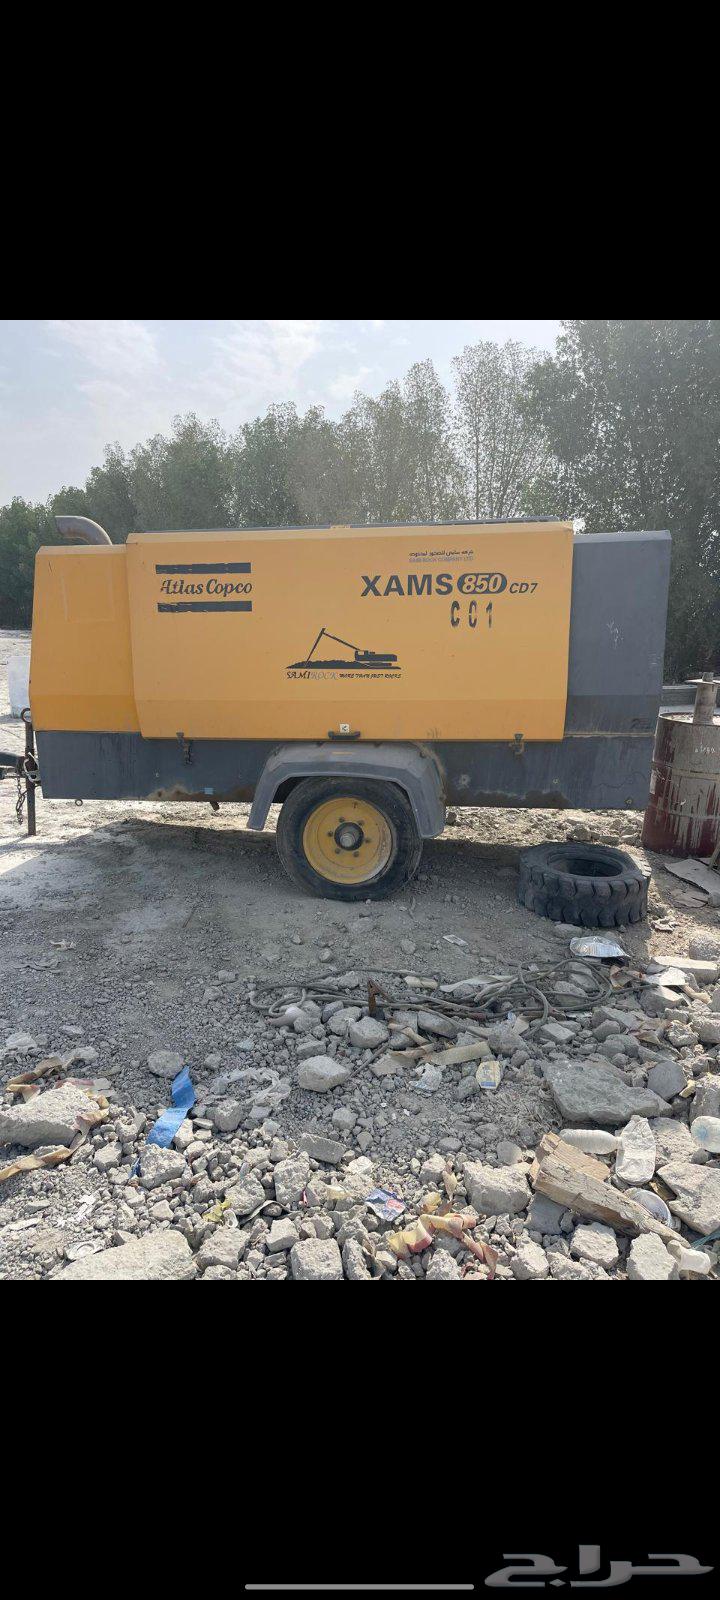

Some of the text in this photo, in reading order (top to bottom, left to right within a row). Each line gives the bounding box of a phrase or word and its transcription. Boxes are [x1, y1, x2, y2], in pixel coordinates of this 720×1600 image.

[160, 579, 252, 597] Atlas Copco
[361, 574, 538, 596] XAMS 850 CD7
